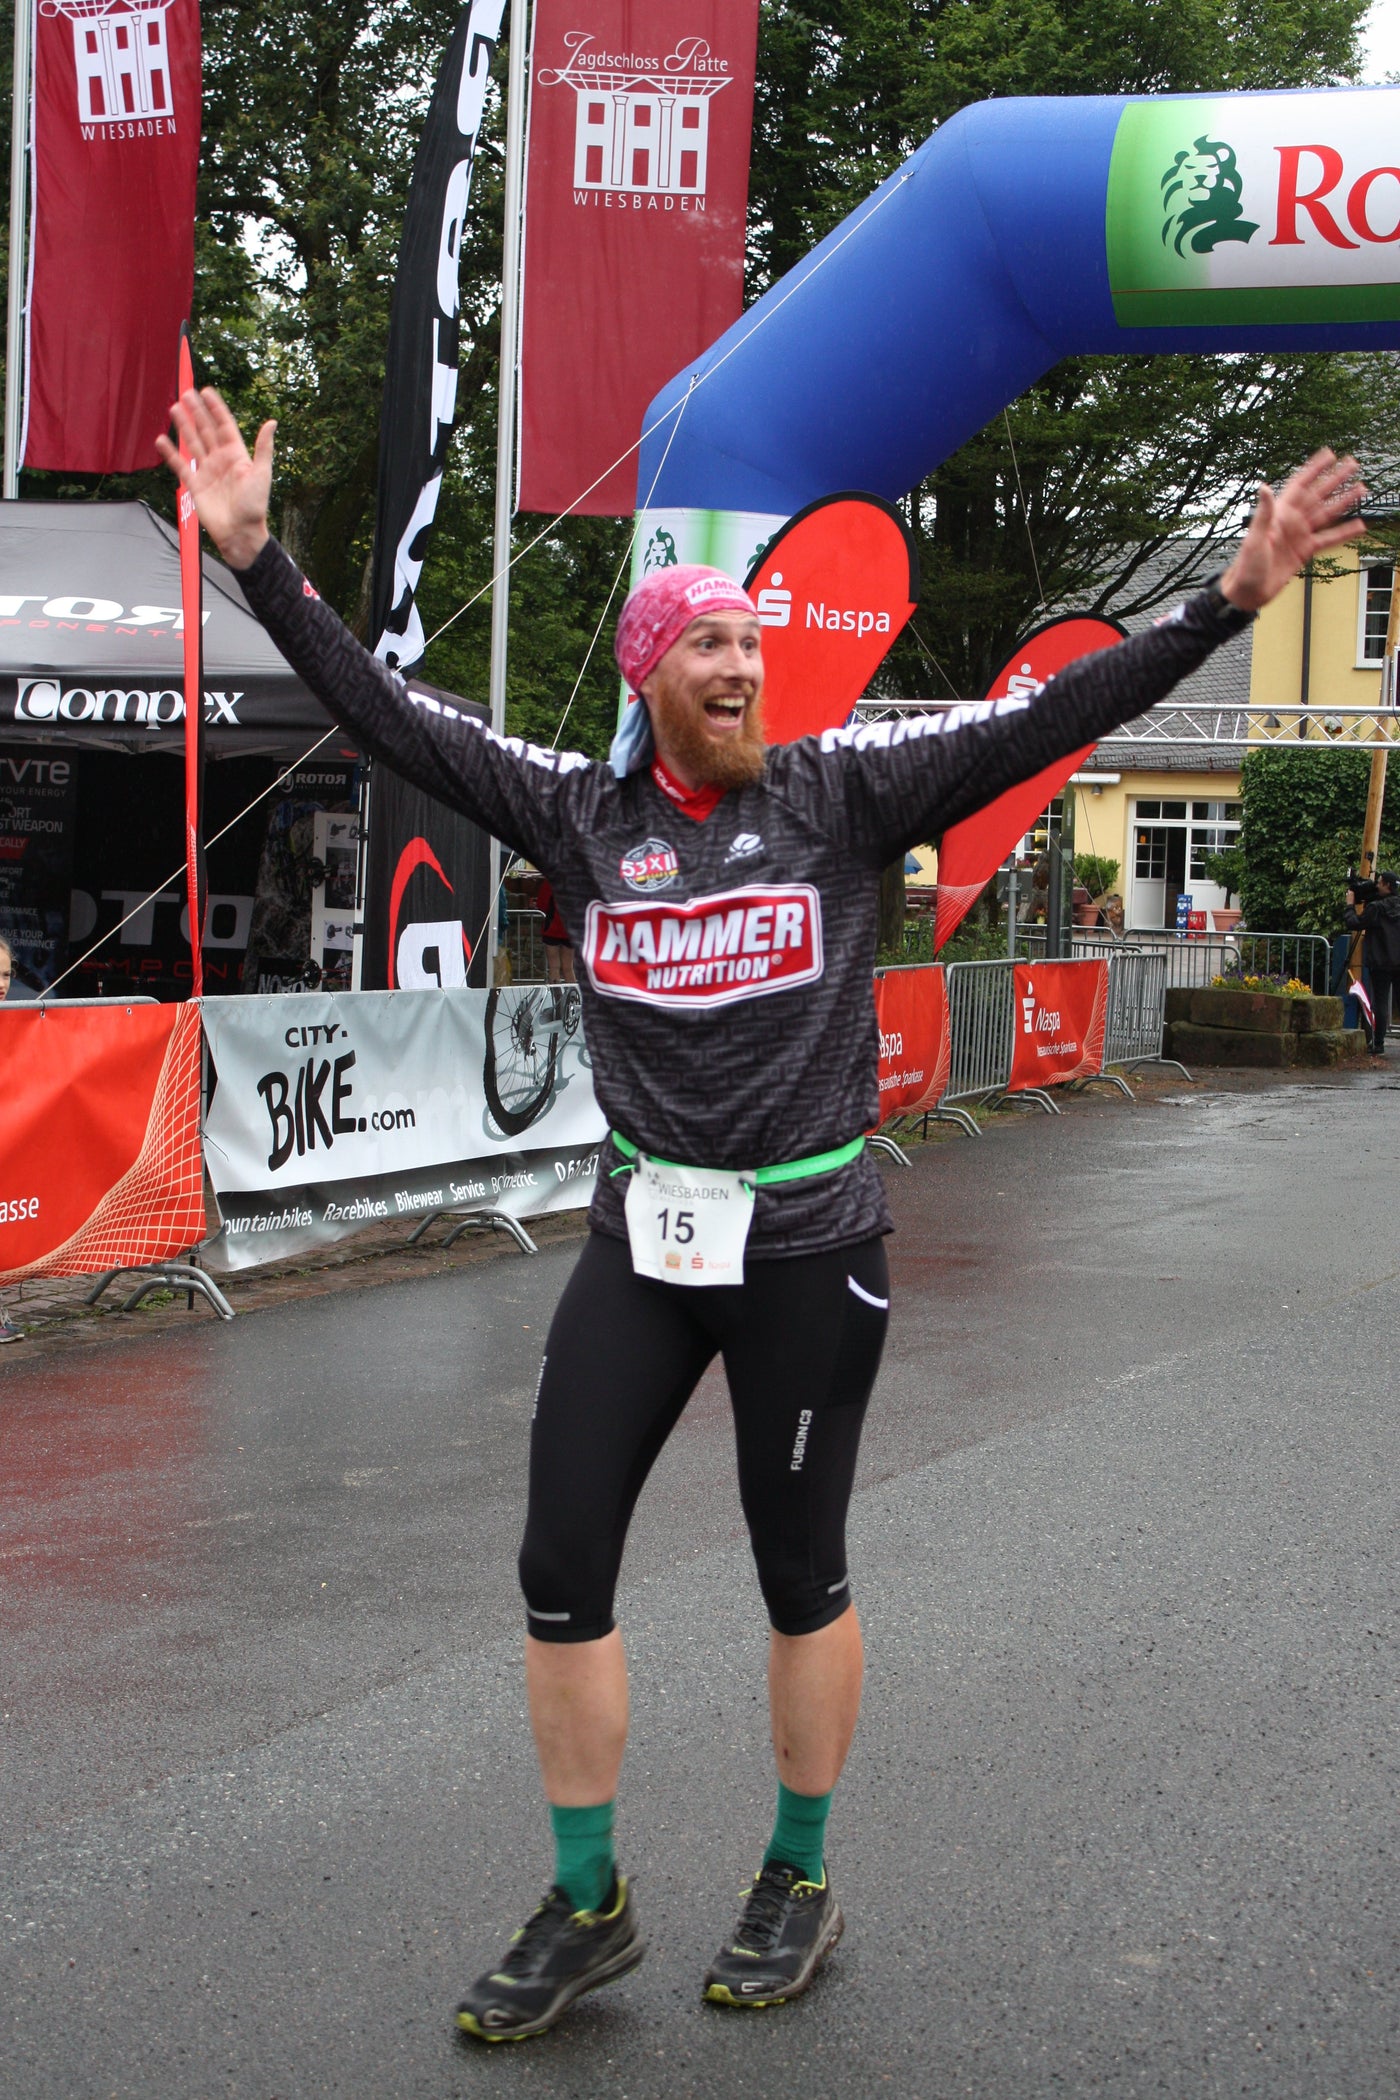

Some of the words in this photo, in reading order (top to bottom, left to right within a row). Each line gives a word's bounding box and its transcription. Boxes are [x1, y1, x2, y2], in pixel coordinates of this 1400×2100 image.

[537, 31, 659, 86] Jagdschloss
[663, 36, 729, 73] Platte
[80, 118, 177, 141] WIESBADEN
[573, 190, 706, 212] WIESBADEN
[805, 602, 891, 638] Naspa
[295, 773, 347, 785] ROTOR
[12, 820, 63, 833] WEAPON
[600, 902, 806, 964] HAMMER
[1034, 1007, 1061, 1037] Naspa
[322, 1197, 388, 1222] Racebikes
[394, 1189, 443, 1213] Bikewear
[449, 1179, 486, 1202] Service
[658, 1182, 730, 1200] WIESBADEN
[657, 1207, 695, 1245] 15
[790, 1425, 810, 1471] FUSION
